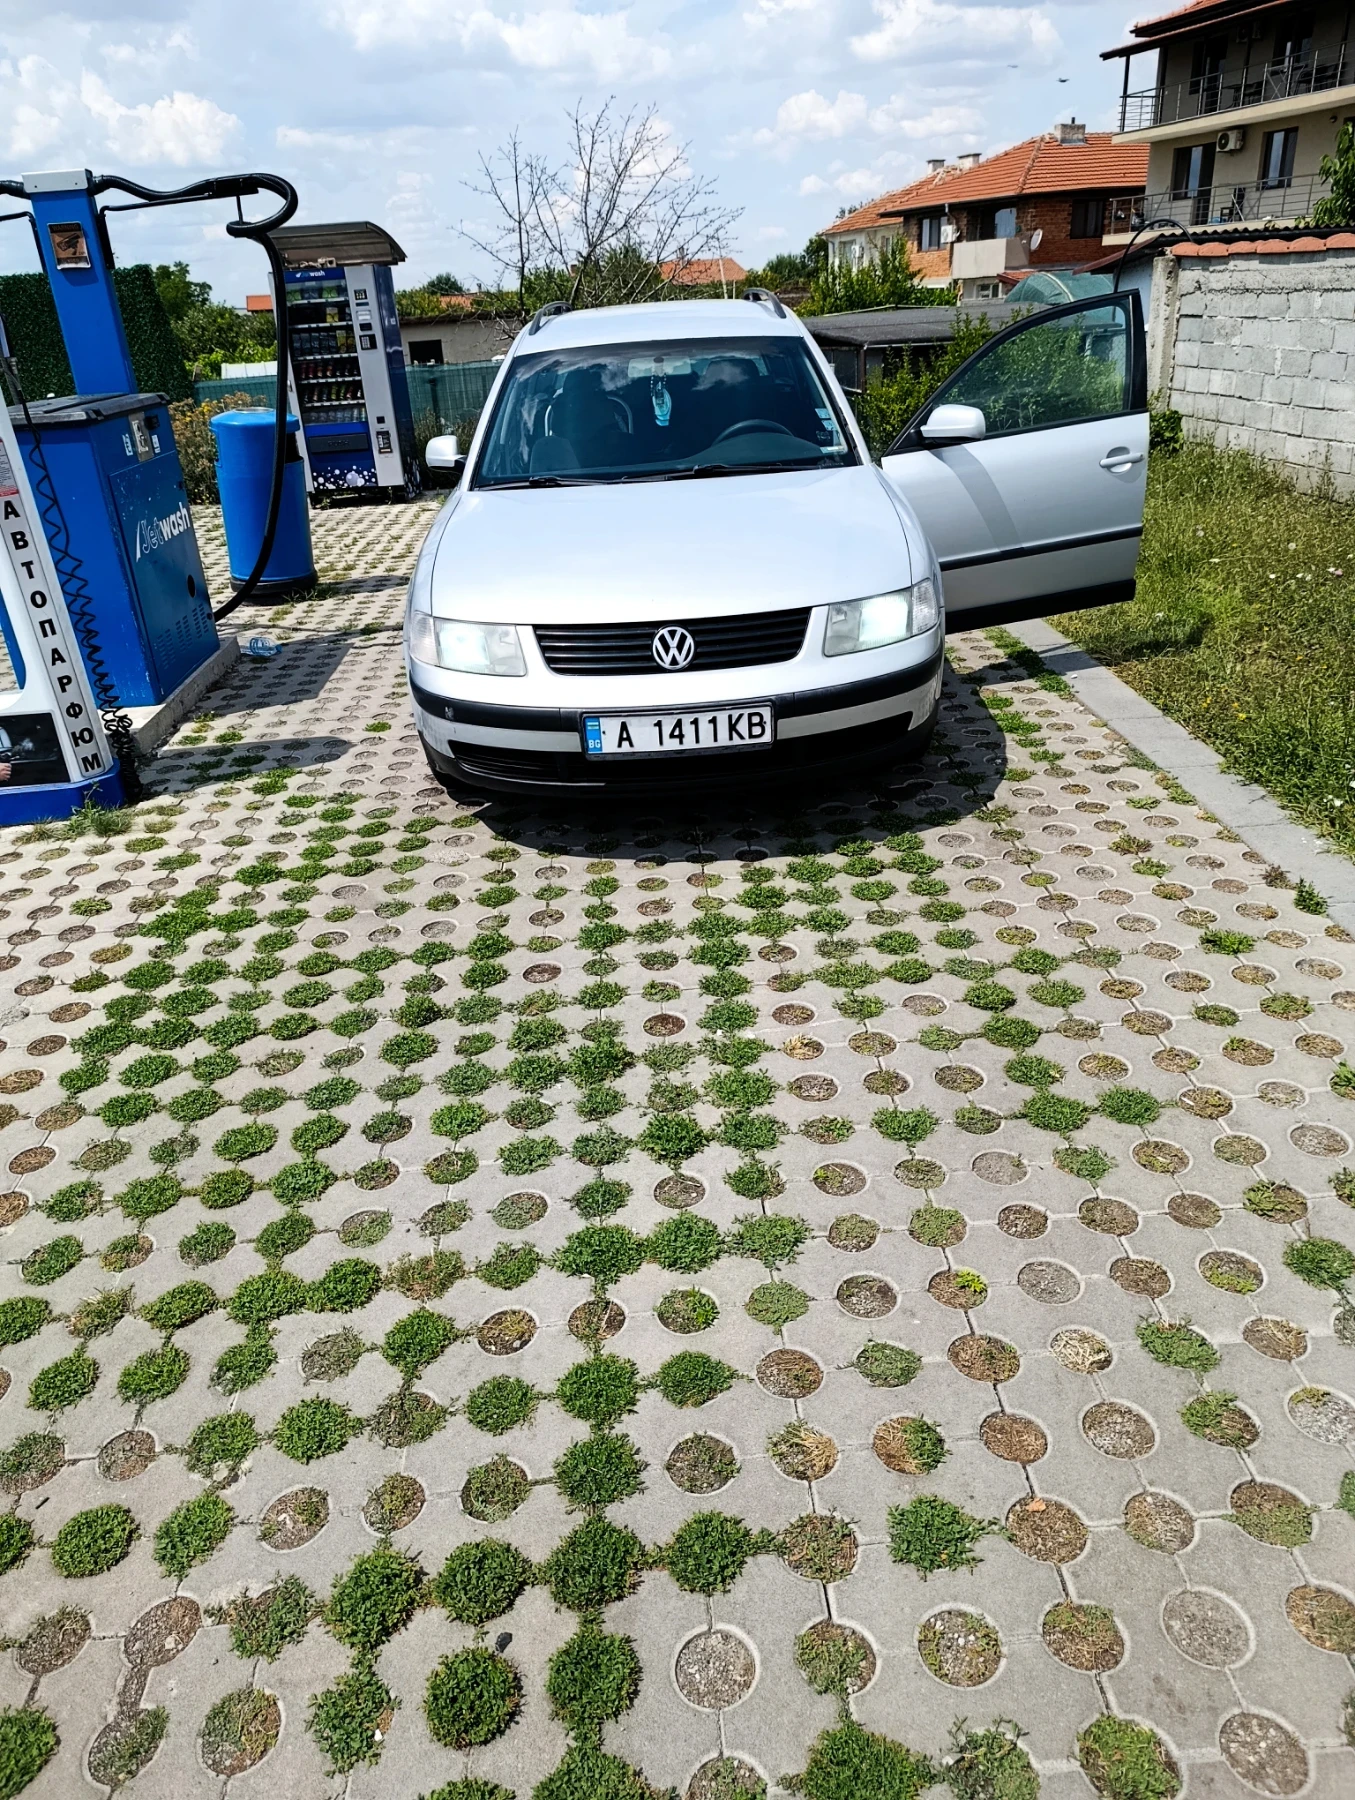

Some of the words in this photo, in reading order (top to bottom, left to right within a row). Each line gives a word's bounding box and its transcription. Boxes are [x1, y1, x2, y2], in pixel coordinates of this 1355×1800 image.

[140, 501, 191, 554] Jetwash
[3, 500, 102, 773] АВТОПАРФЮМ
[653, 626, 695, 670] VW
[588, 740, 601, 748] BG
[617, 721, 634, 748] A
[653, 712, 766, 746] 1411KB
